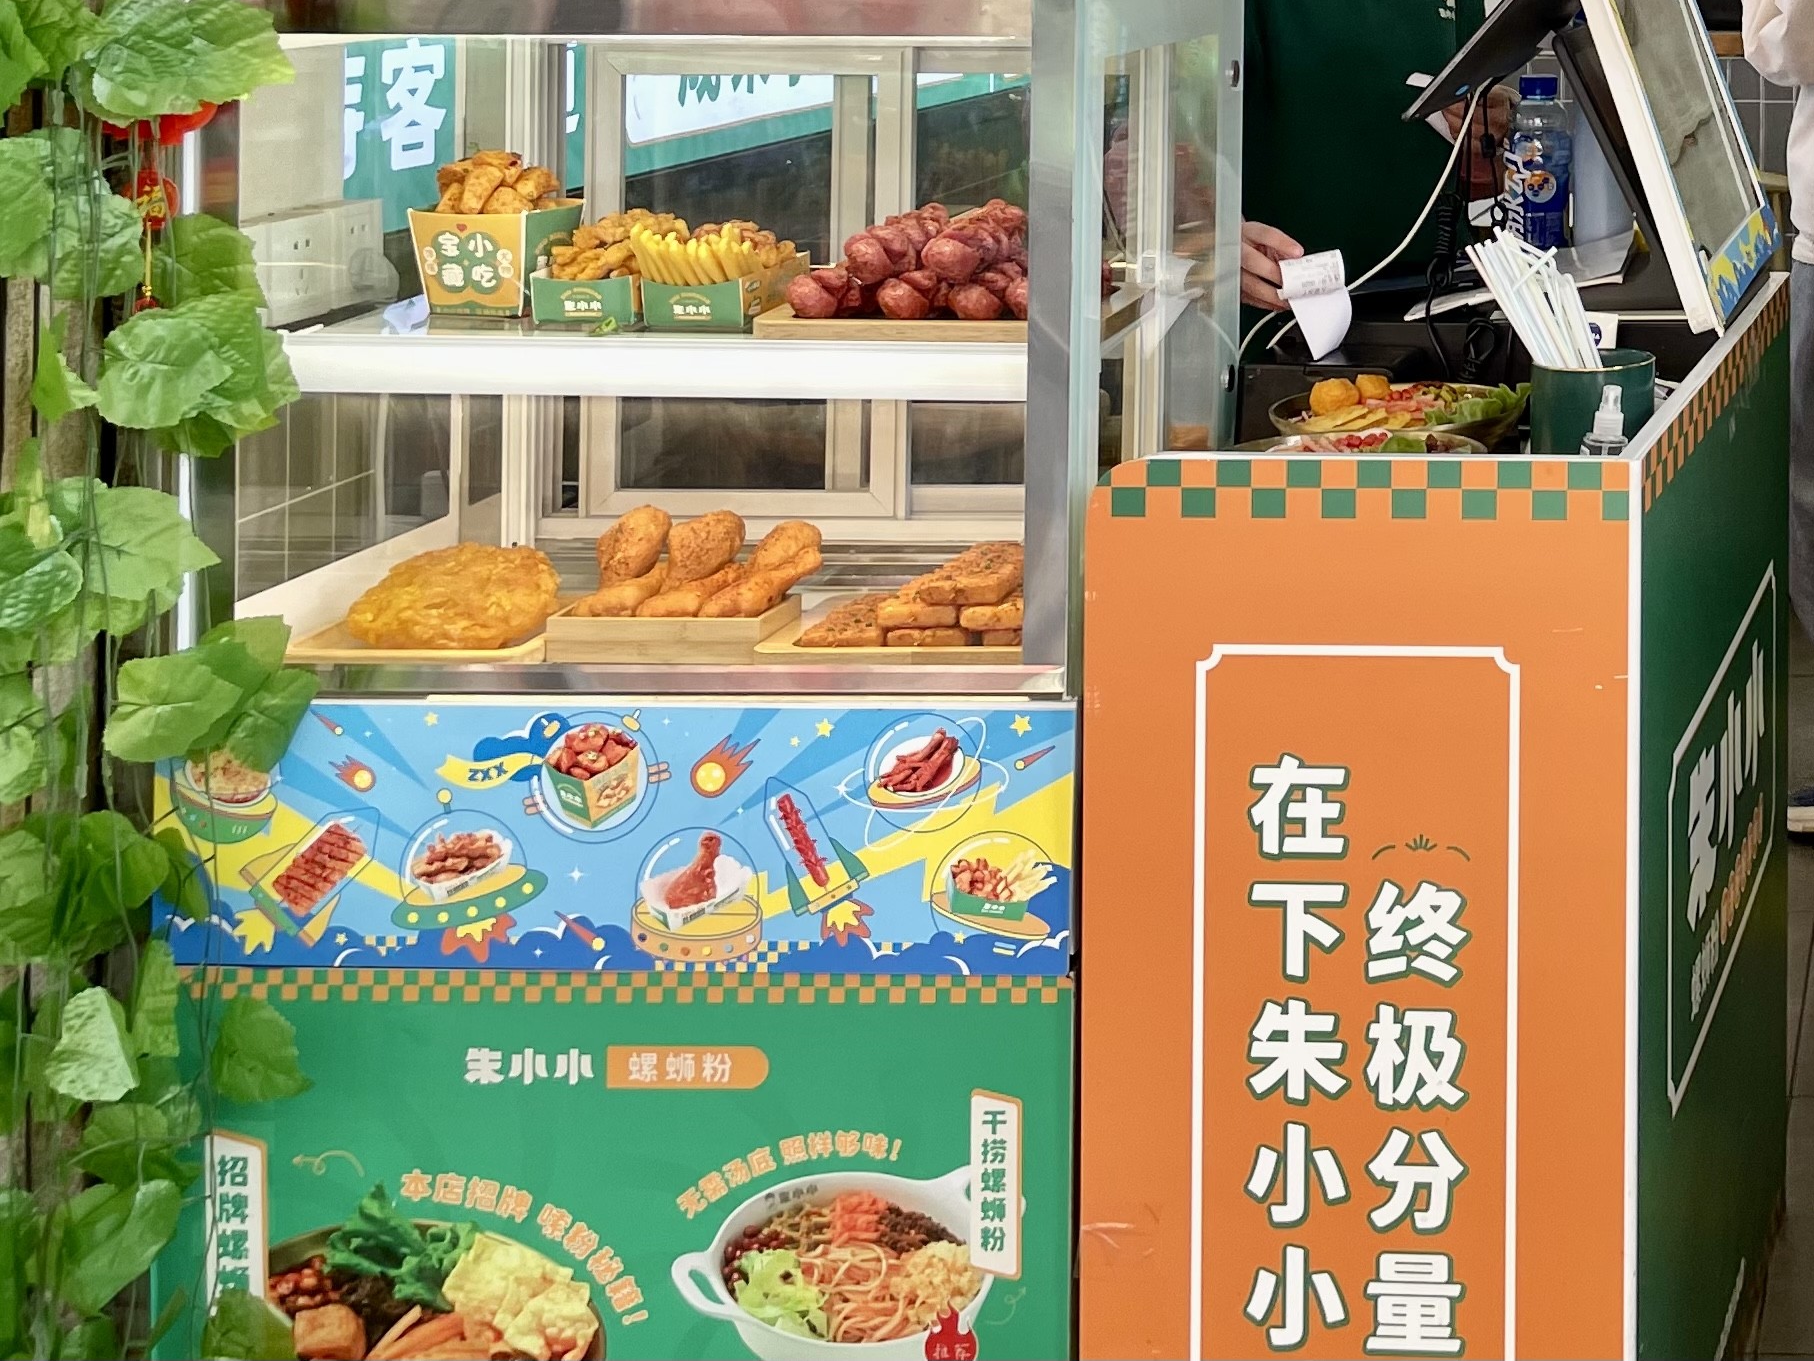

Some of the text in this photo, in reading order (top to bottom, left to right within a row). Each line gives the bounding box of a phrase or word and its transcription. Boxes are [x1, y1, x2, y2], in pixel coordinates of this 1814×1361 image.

[466, 761, 510, 785] ZXX
[464, 1046, 733, 1086] 朱小小 螺蛳粉
[1245, 752, 1350, 1347] 在下朱小小
[1363, 878, 1470, 1355] 终极分量
[400, 1168, 534, 1224] 本店招牌
[675, 1130, 903, 1221] 无需汤底 照样够味!
[980, 1110, 1008, 1253] 干捞螺蛳粉
